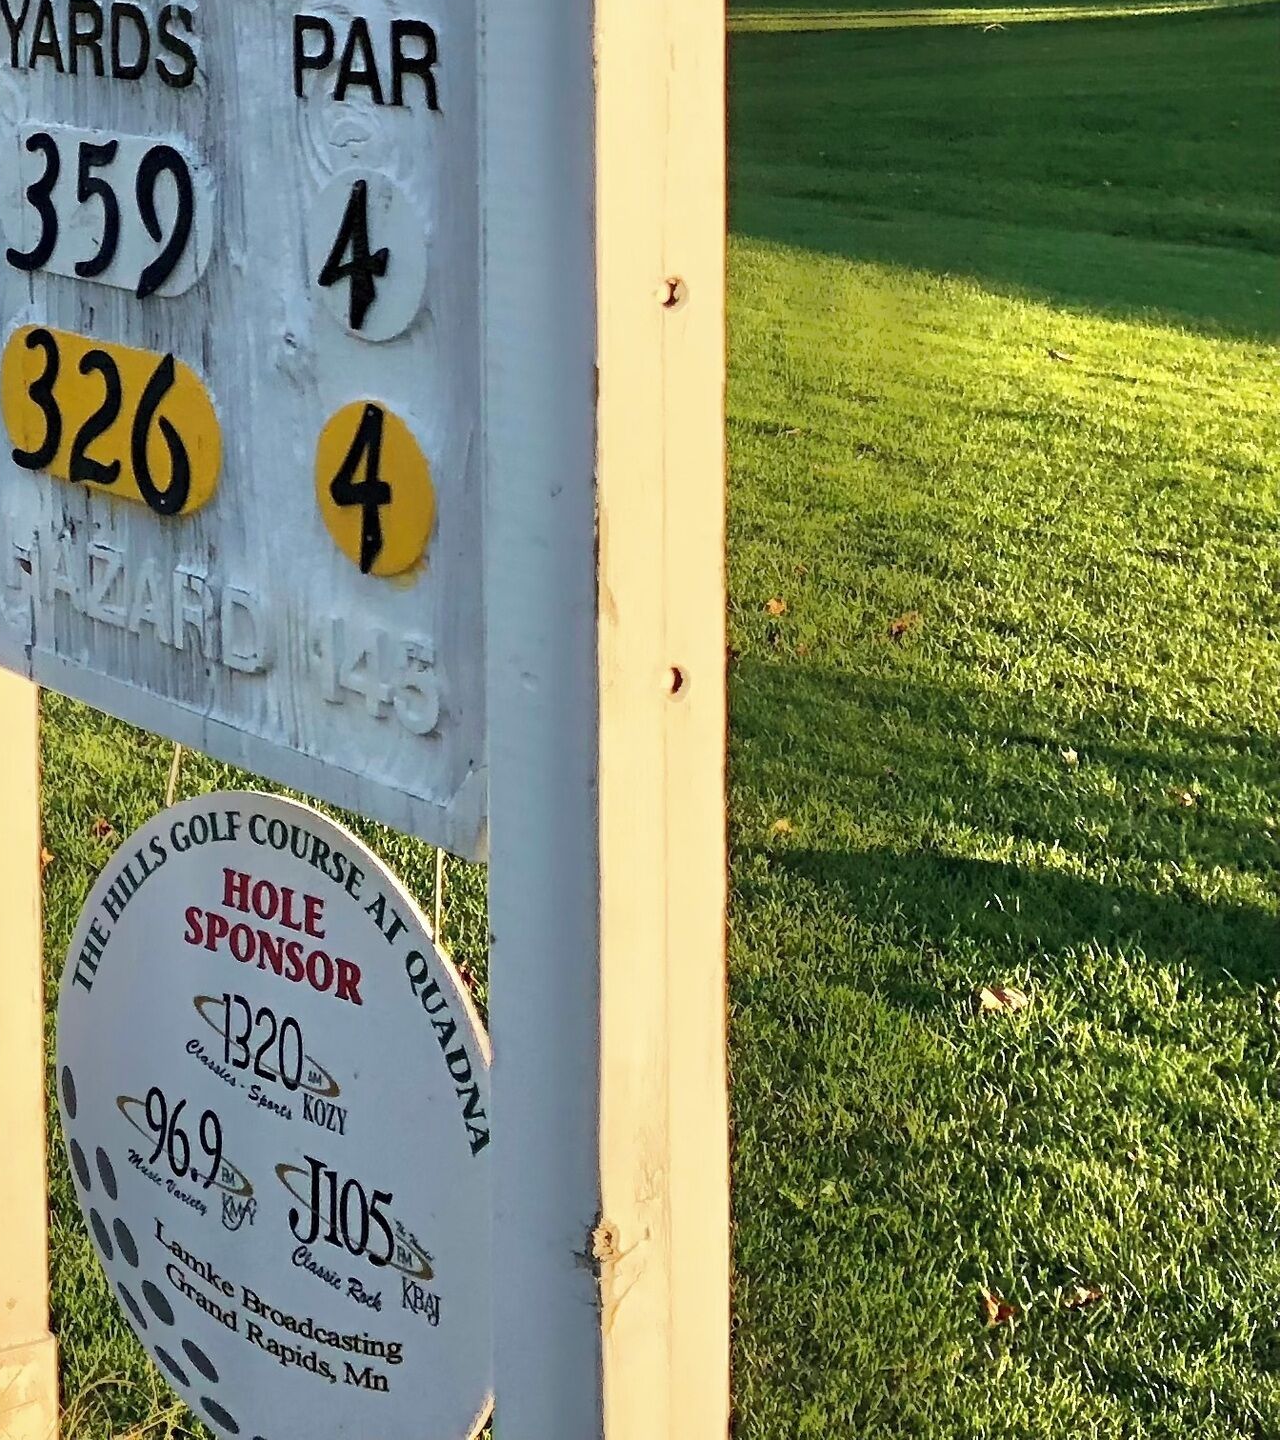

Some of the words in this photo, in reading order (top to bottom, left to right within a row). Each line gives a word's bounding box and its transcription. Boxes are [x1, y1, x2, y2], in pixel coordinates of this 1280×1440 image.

[293, 14, 440, 112] PAR
[6, 132, 194, 299] 359
[318, 178, 390, 331] 4
[12, 328, 191, 516] 326
[330, 402, 391, 575] 4
[222, 867, 326, 939] HOLE
[72, 916, 111, 994] THE
[101, 835, 169, 924] HILLS
[170, 810, 242, 852] GOLF
[248, 813, 366, 901] COURSE
[365, 892, 409, 946] AT
[404, 949, 492, 1157] QUADNA
[184, 906, 364, 1006] SPONSOR
[222, 992, 304, 1091] 1320
[145, 1086, 223, 1189] 96.9
[302, 1092, 348, 1136] KOZY
[127, 1148, 162, 1186] Music
[166, 1178, 208, 1217] Variety
[288, 1155, 395, 1267] J105
[154, 1216, 236, 1298] Lamke
[241, 1284, 404, 1365] Broadcasting
[165, 1263, 240, 1334] Grand
[244, 1318, 338, 1385] Rapids,
[344, 1360, 390, 1394] Mn
[291, 1245, 342, 1291] Classic
[346, 1276, 383, 1312] Rock
[401, 1275, 441, 1327] KBAJ
